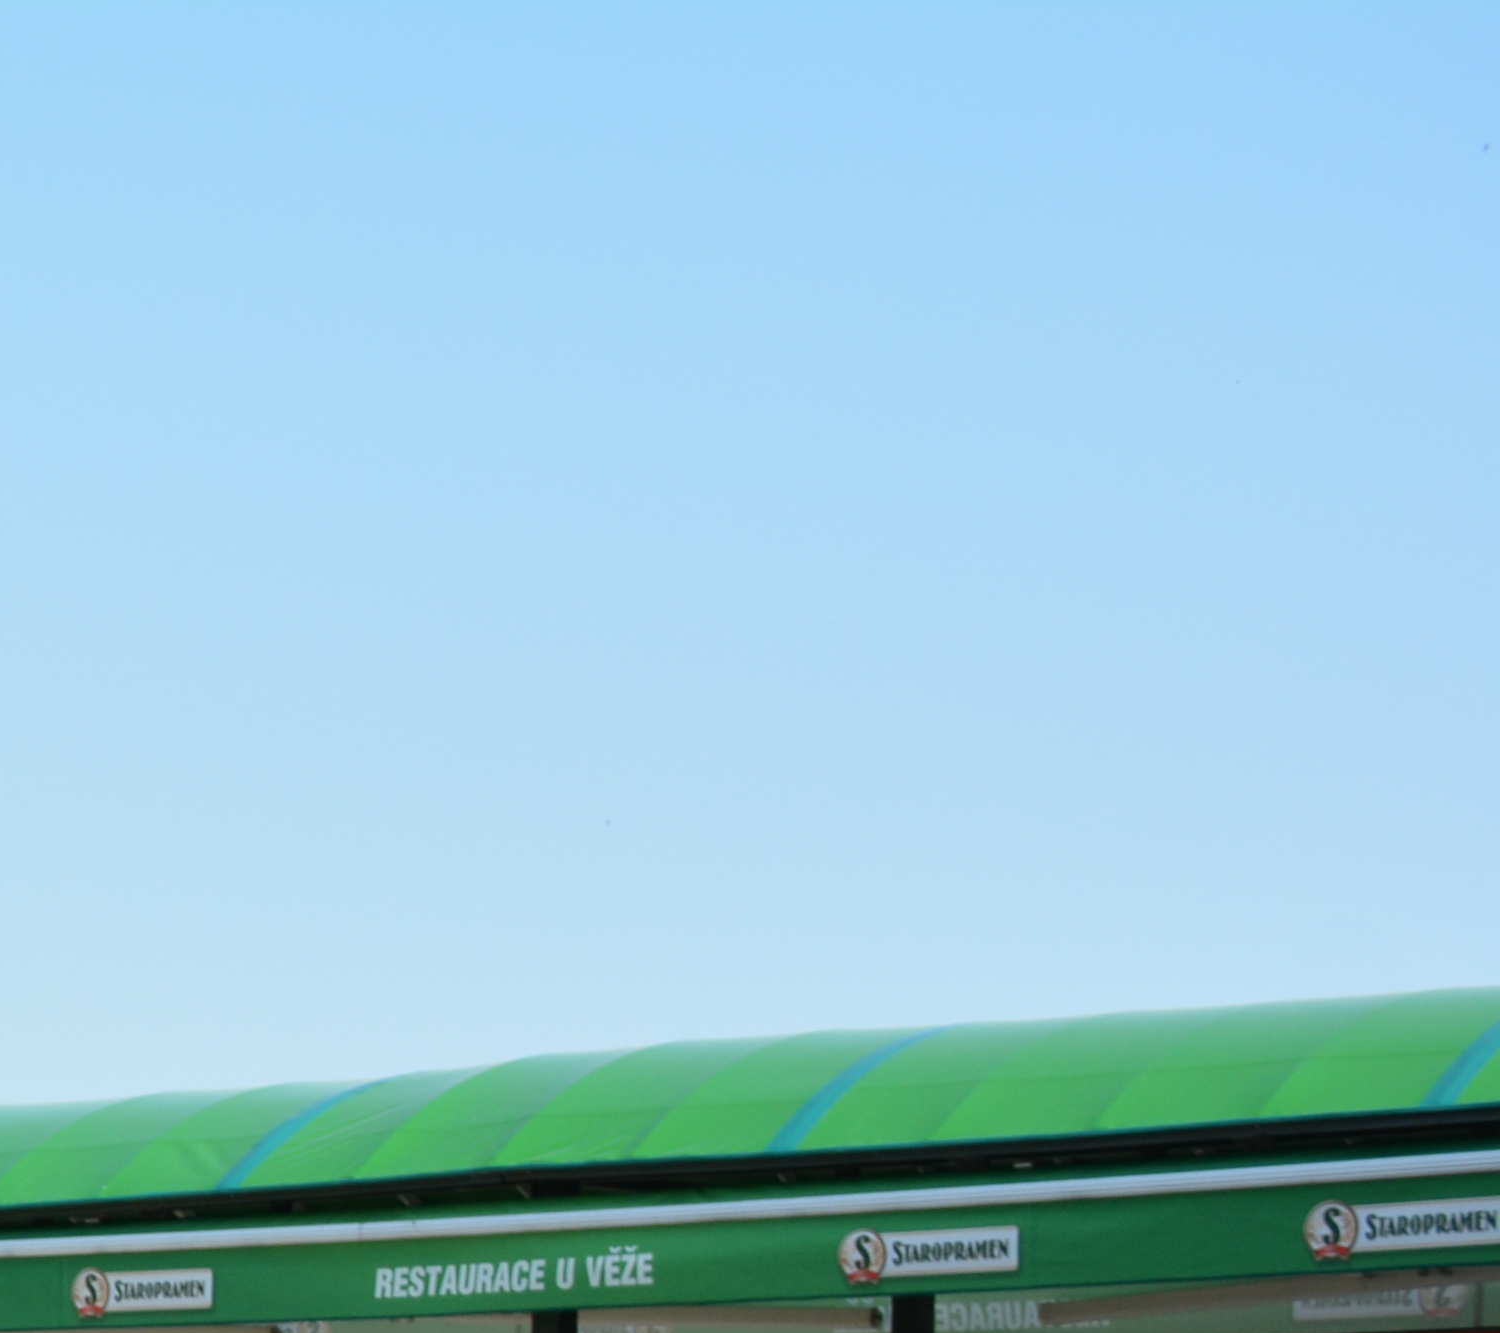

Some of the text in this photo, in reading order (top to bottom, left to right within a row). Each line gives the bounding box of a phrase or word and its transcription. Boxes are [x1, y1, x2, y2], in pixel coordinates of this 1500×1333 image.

[374, 1245, 654, 1299] RESTAURACE U VĚŽE
